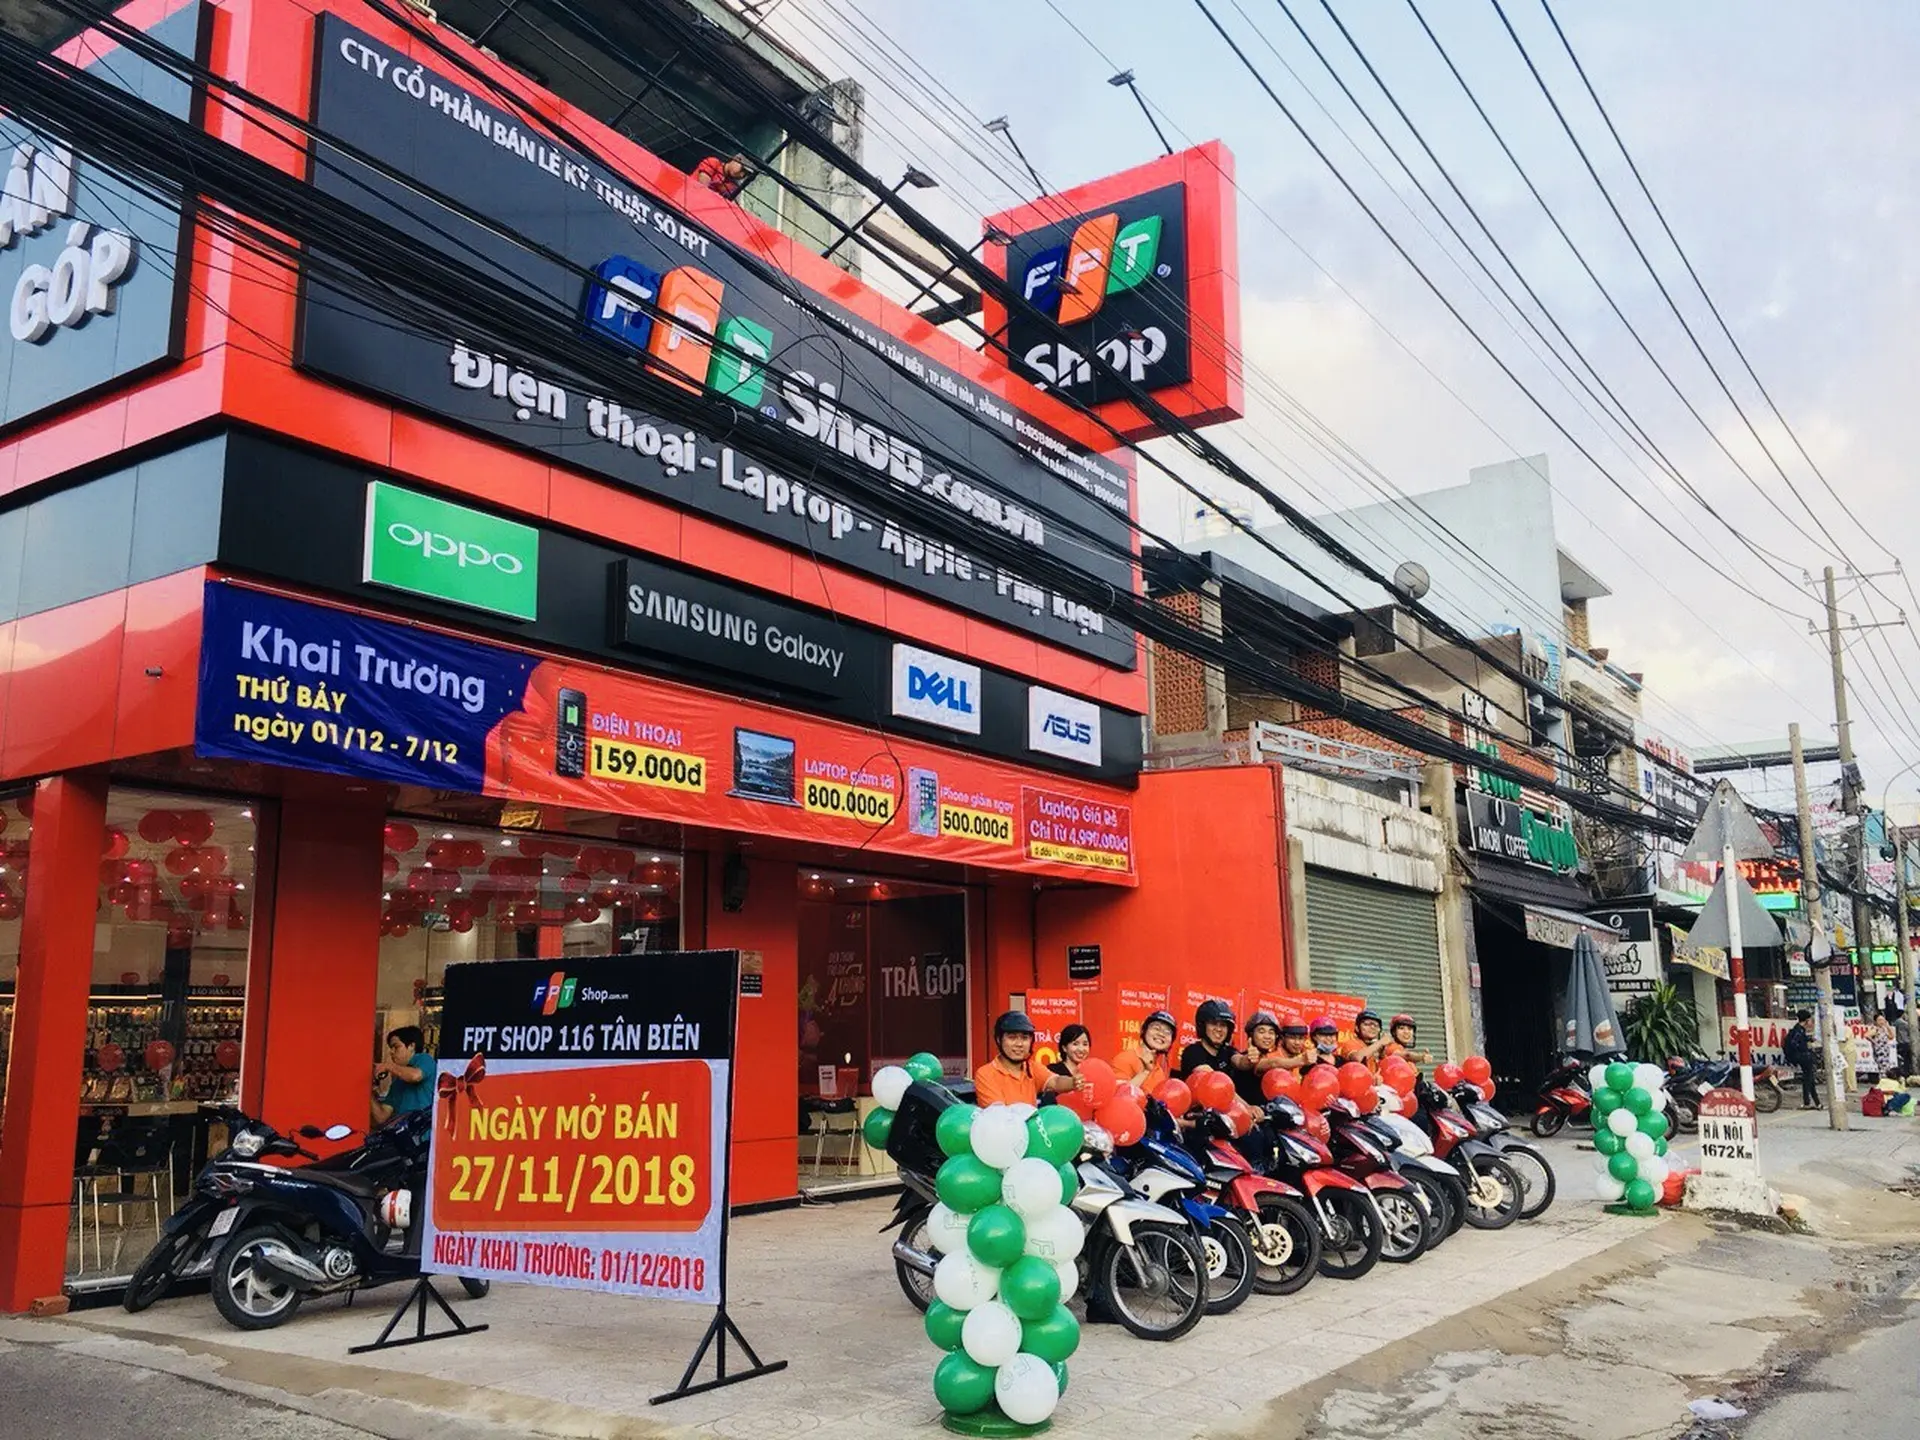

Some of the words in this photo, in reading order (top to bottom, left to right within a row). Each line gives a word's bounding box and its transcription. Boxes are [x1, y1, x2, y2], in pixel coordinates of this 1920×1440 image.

[340, 38, 388, 79] CTY
[392, 65, 425, 99] CỔ
[430, 93, 490, 136] PHẦN
[493, 121, 535, 162] BÁN
[679, 221, 708, 257] FPT
[10, 221, 131, 342] GÓP
[588, 396, 697, 477] thoại
[721, 448, 853, 539] Laptop
[388, 522, 523, 574] oppo
[628, 584, 757, 648] SAMSUNG
[765, 625, 845, 678] Galaxy
[241, 621, 341, 676] Khai
[355, 644, 485, 713] Trương
[908, 665, 972, 714] DELL
[236, 674, 290, 703] THỨ
[297, 682, 347, 714] BẢY
[234, 713, 304, 743] ngày
[311, 720, 384, 754] 01/12
[406, 735, 458, 764] 7/12
[592, 712, 631, 739] ĐIỆN
[634, 721, 682, 749] THOẠI
[1043, 714, 1092, 745] ASUS
[594, 744, 703, 787] 159.000đ
[804, 758, 848, 781] LAPTOP
[808, 784, 889, 819] 800.000đ
[943, 809, 1009, 840] 500.000đ
[1039, 796, 1080, 823] Laptop
[882, 956, 920, 997] TRẢ
[925, 957, 965, 995] GÓP
[463, 1026, 497, 1052] FPT
[501, 1026, 552, 1052] SHOP
[558, 1023, 595, 1052] 116
[601, 1015, 641, 1051] TÂN
[647, 1013, 700, 1051] BIÊN
[469, 1095, 547, 1140] NGÀY
[556, 1093, 607, 1139] MỞ
[614, 1091, 678, 1138] BÁN
[1703, 1121, 1719, 1140] HÀ
[450, 1154, 696, 1213] 27/11/2018
[433, 1230, 476, 1266] NGÀY
[480, 1238, 516, 1272] KHAI
[523, 1242, 596, 1280] TRƯƠNG:
[601, 1251, 705, 1292] 01/12/2018
